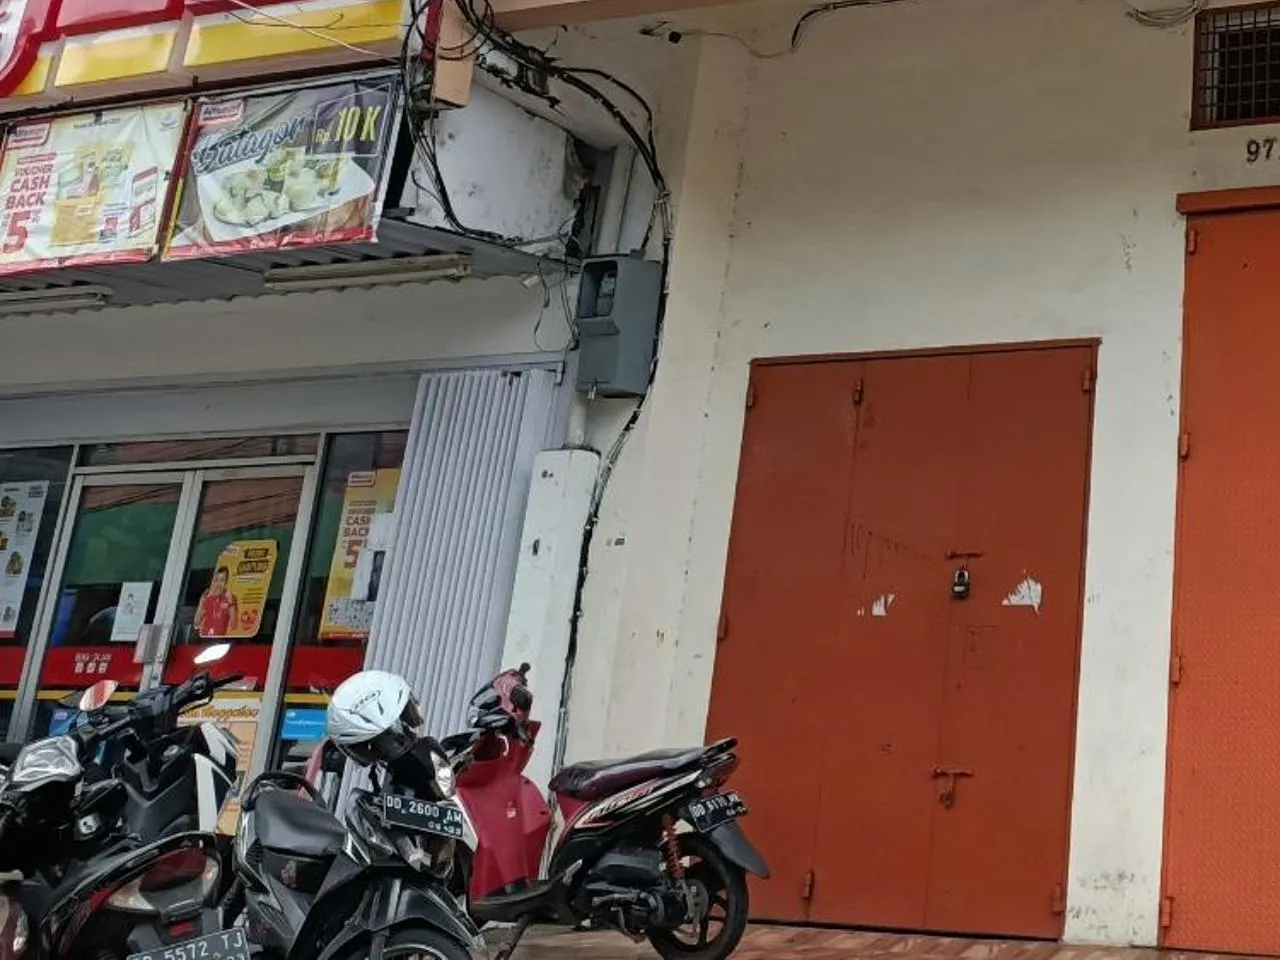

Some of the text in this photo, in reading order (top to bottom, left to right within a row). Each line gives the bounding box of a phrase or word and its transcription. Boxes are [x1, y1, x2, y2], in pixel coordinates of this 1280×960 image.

[10, 175, 51, 193] CASH
[5, 192, 46, 210] BACK
[408, 800, 440, 818] 2600
